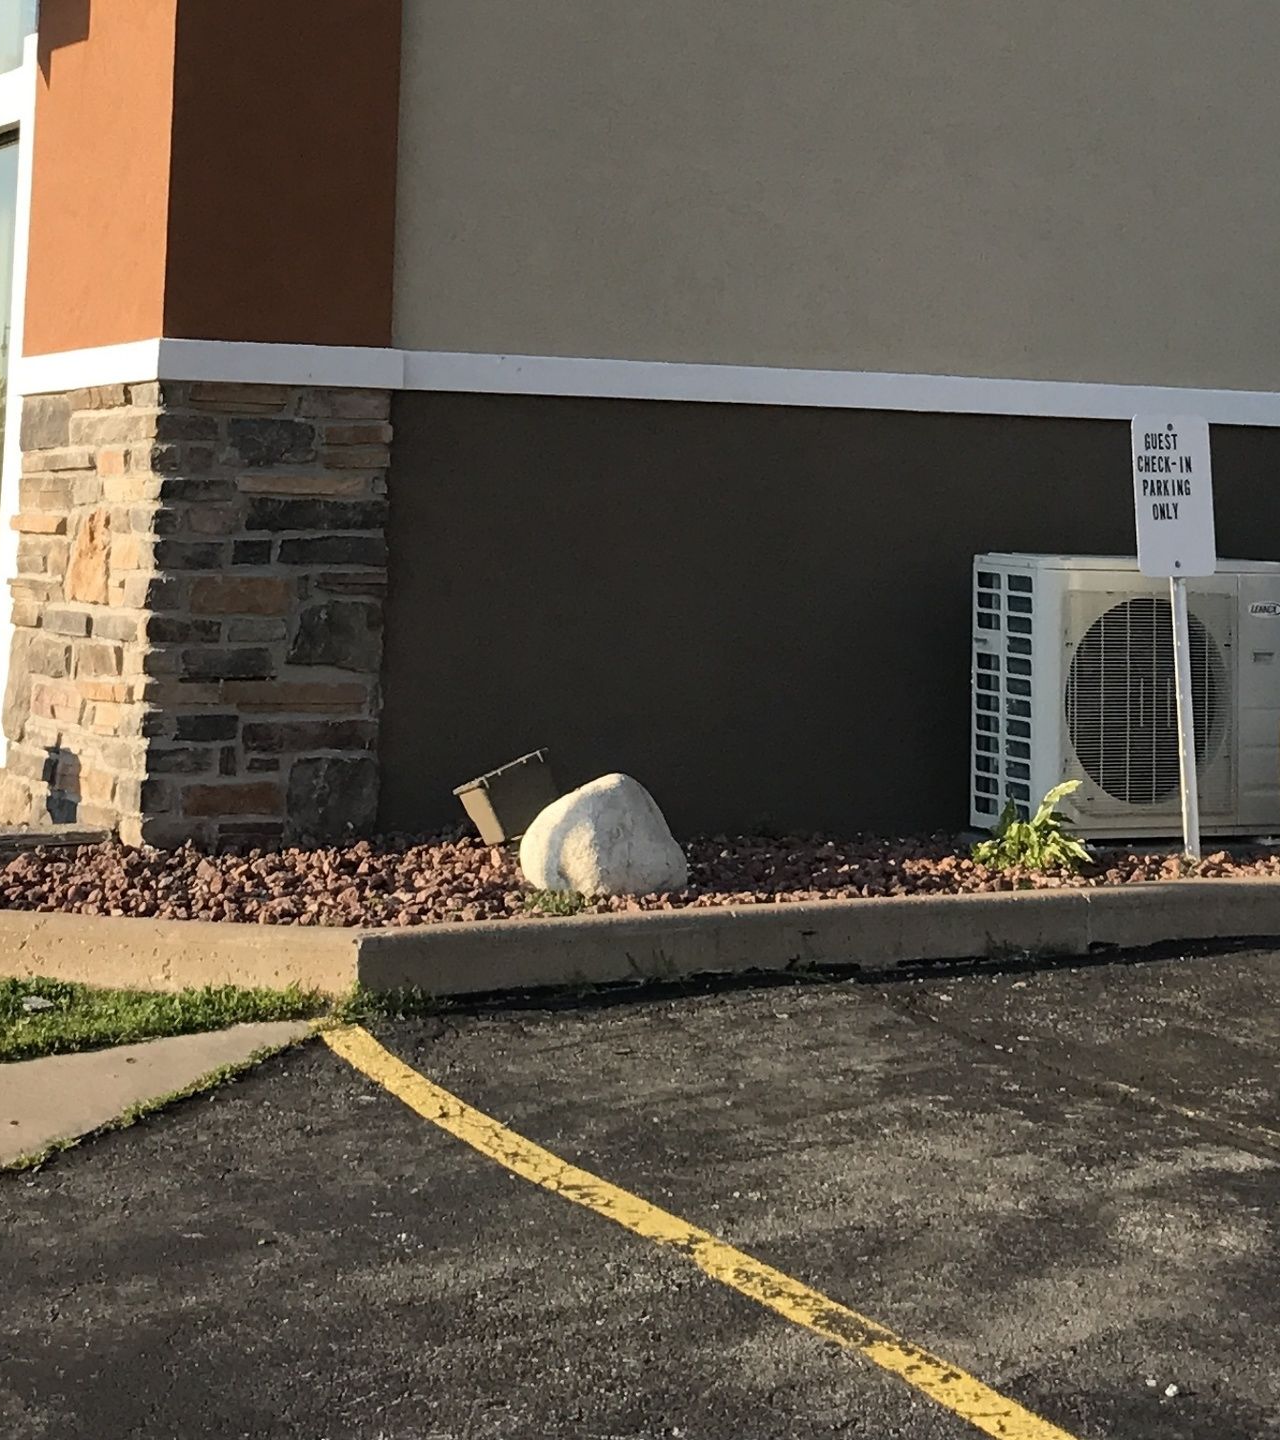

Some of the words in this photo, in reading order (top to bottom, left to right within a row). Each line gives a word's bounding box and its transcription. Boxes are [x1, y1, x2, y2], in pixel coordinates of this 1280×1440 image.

[1144, 433, 1178, 451] GUEST
[1137, 455, 1193, 473] CHECK-IN
[1142, 479, 1191, 497] PARKING
[1152, 503, 1179, 521] ONLY
